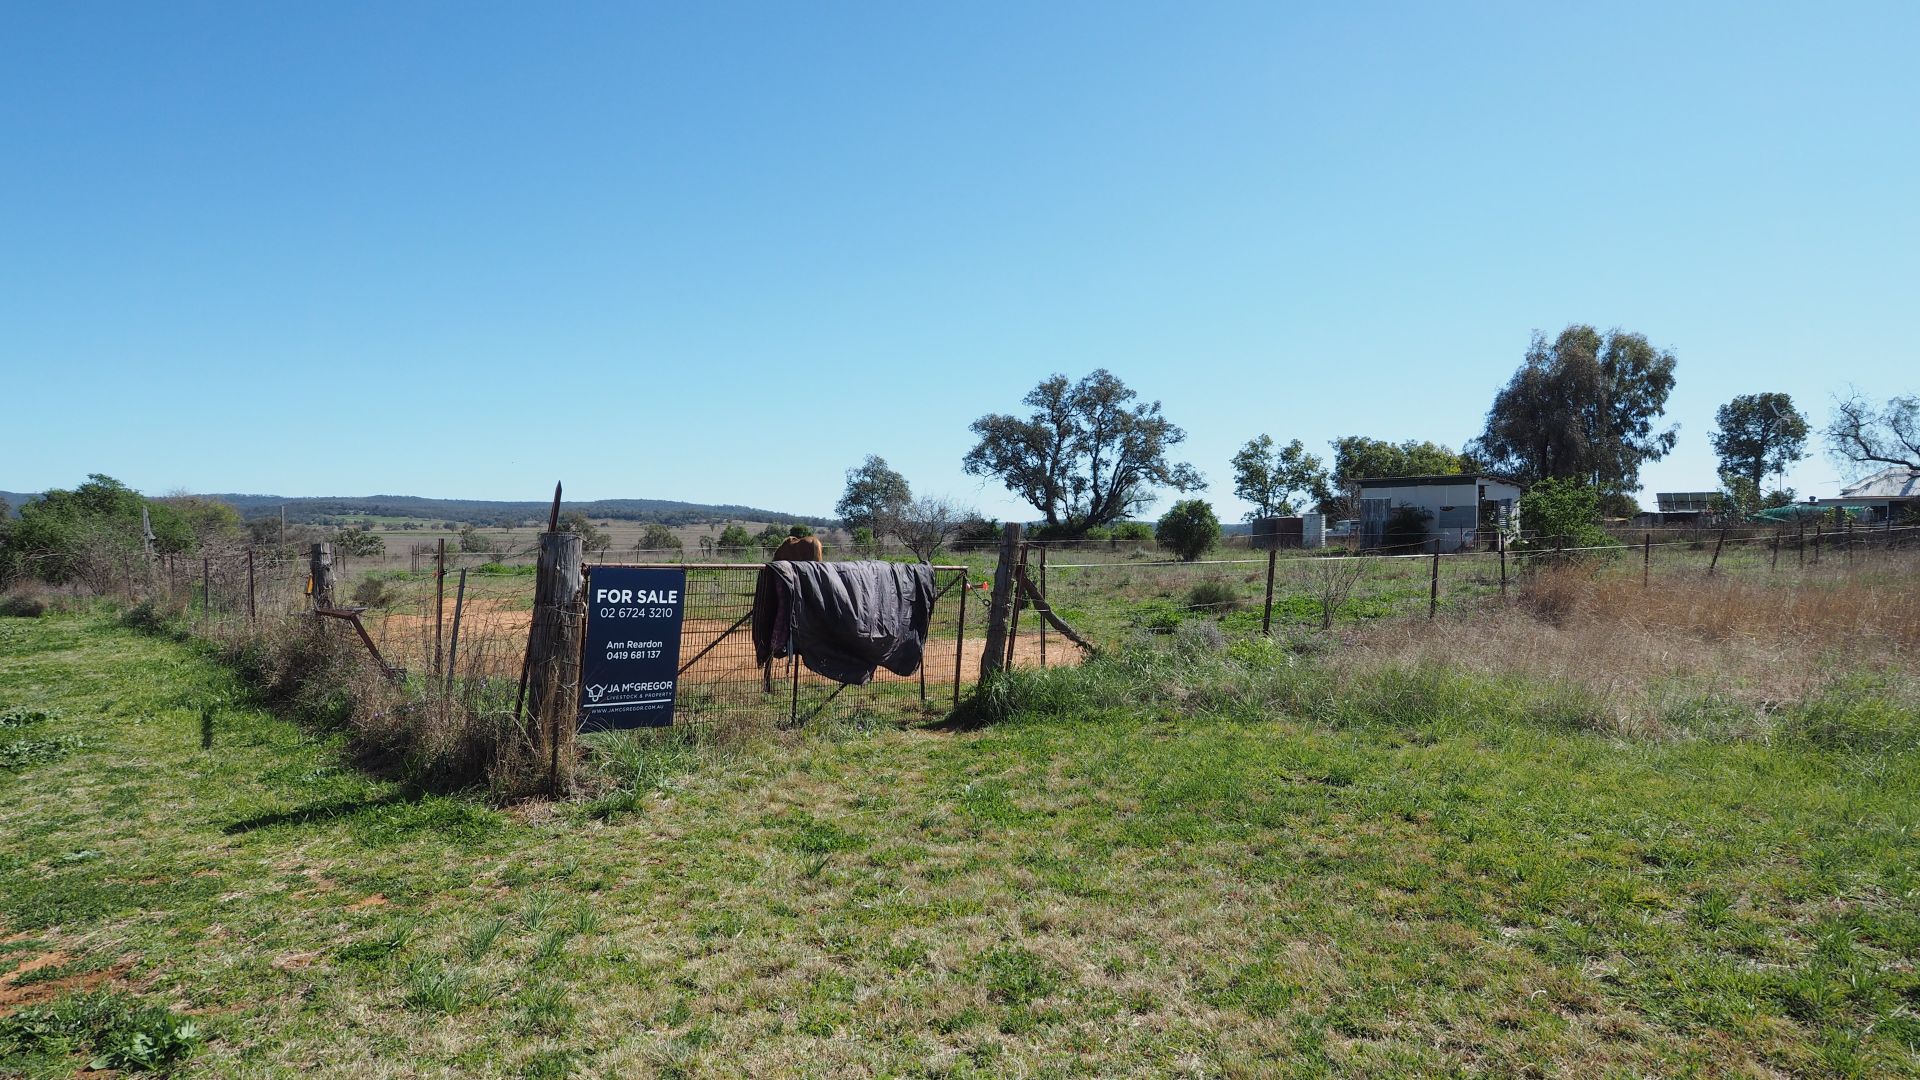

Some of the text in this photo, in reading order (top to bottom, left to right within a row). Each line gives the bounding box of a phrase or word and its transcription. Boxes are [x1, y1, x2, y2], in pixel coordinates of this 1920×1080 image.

[597, 589, 677, 604] FOR SALE
[600, 608, 673, 618] 02 6724 3210
[606, 640, 663, 650] Ann Reardon
[606, 650, 661, 660] 0419 681 137
[607, 683, 620, 693] JA
